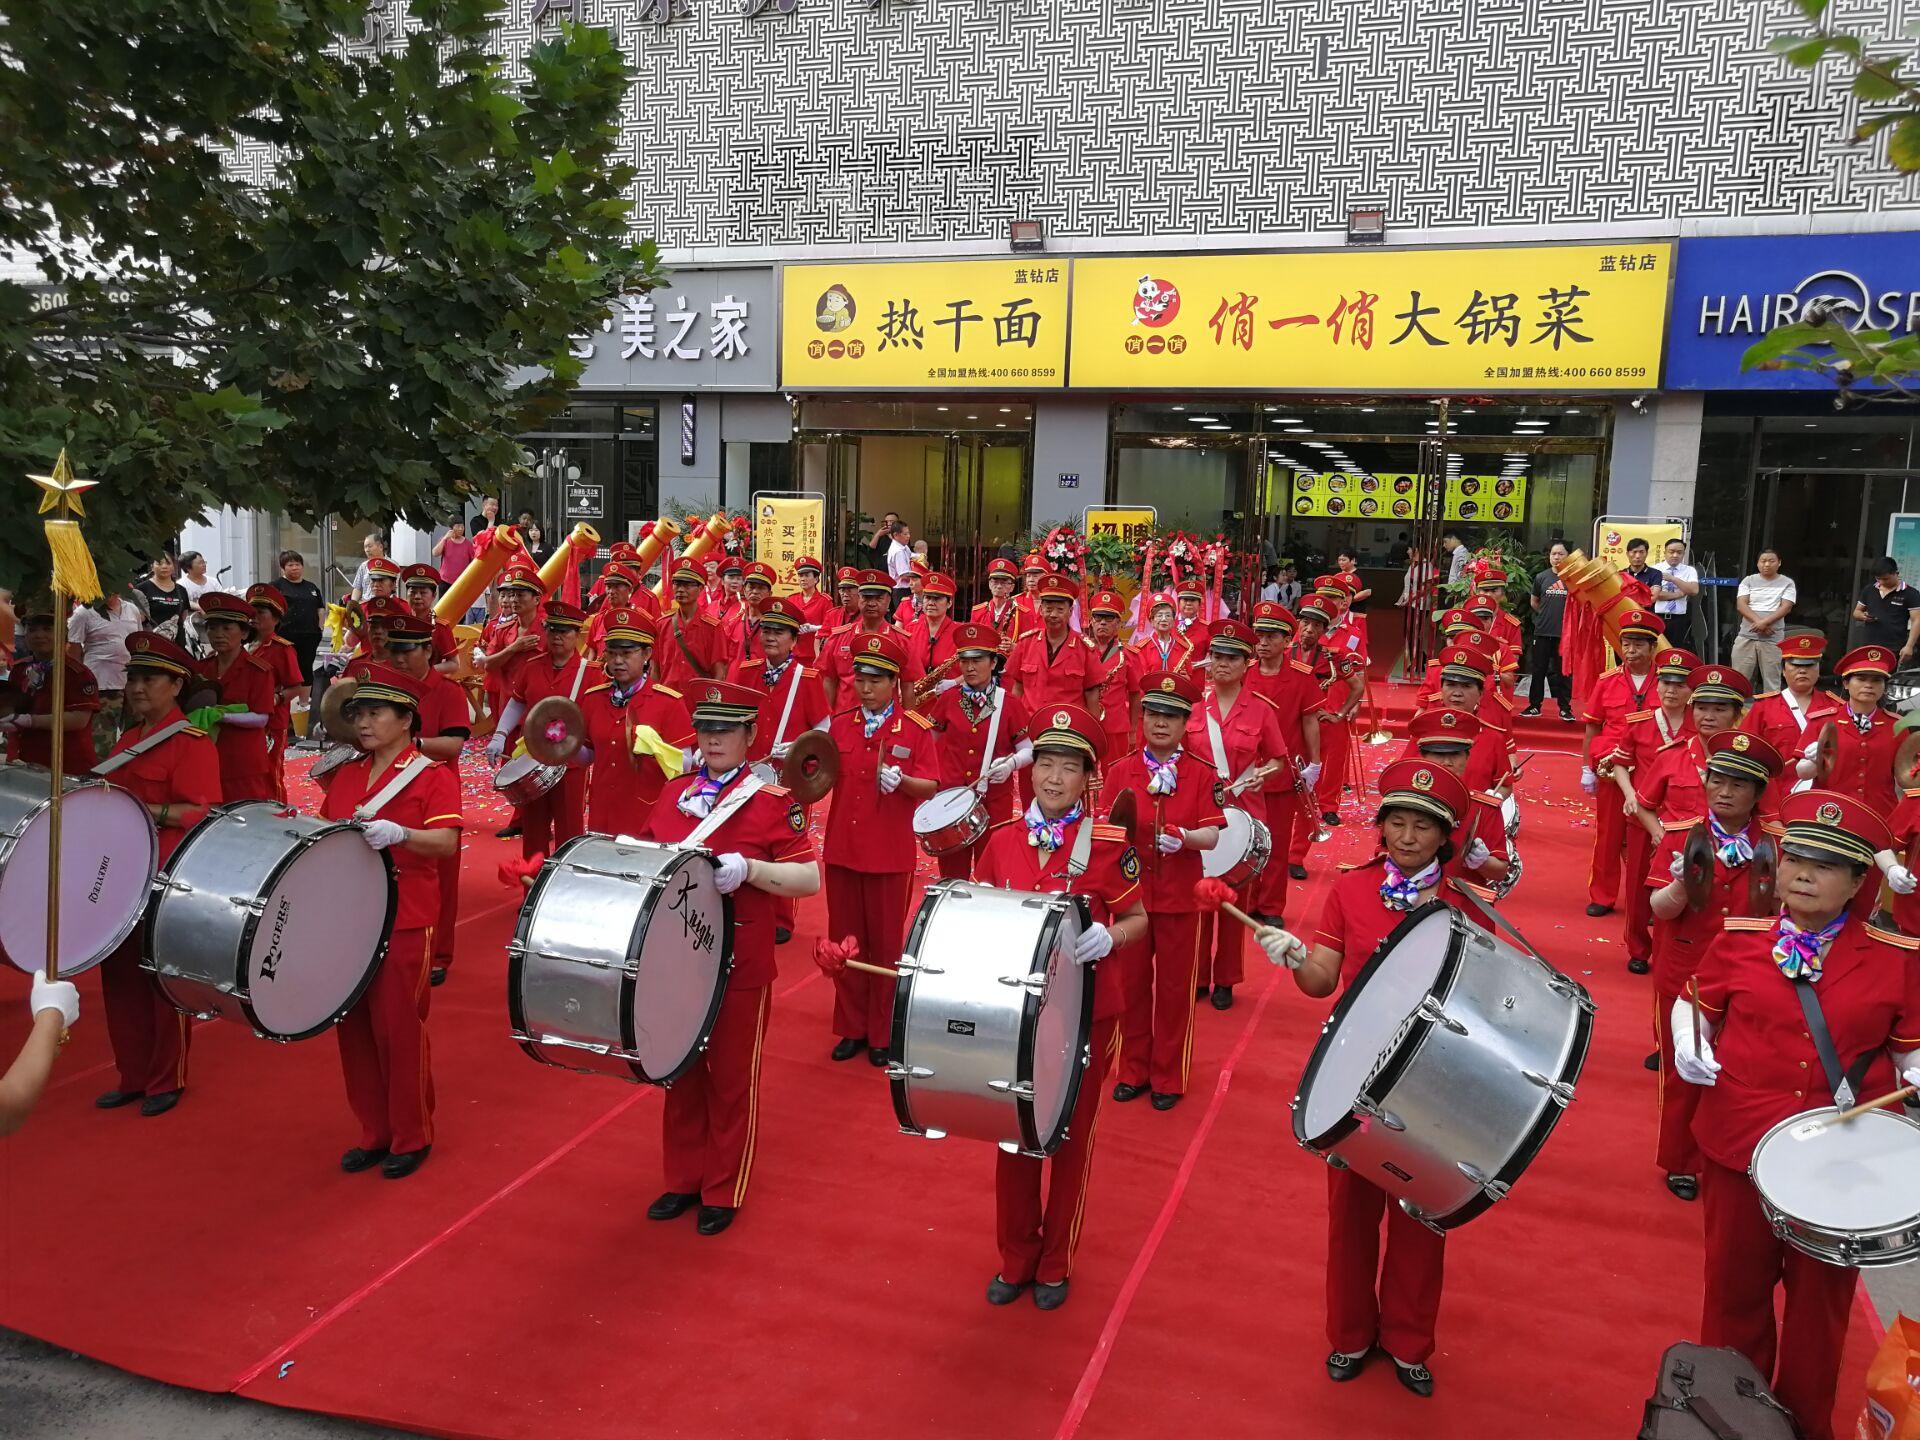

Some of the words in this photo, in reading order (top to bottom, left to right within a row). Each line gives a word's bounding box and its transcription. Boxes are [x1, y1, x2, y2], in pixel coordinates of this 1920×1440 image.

[1599, 253, 1657, 272] 蓝钻店
[1014, 268, 1060, 284] 蓝钻店
[876, 297, 1042, 353] 热干面
[1208, 284, 1594, 352] 俏一俏大锅菜
[808, 340, 865, 359] 俏一俏
[1125, 335, 1187, 355] 俏一俏
[1011, 368, 1029, 378] 660
[1031, 367, 1056, 378] 8599
[1589, 368, 1612, 377] 660
[1615, 367, 1646, 377] 8599
[668, 870, 715, 953] Knight
